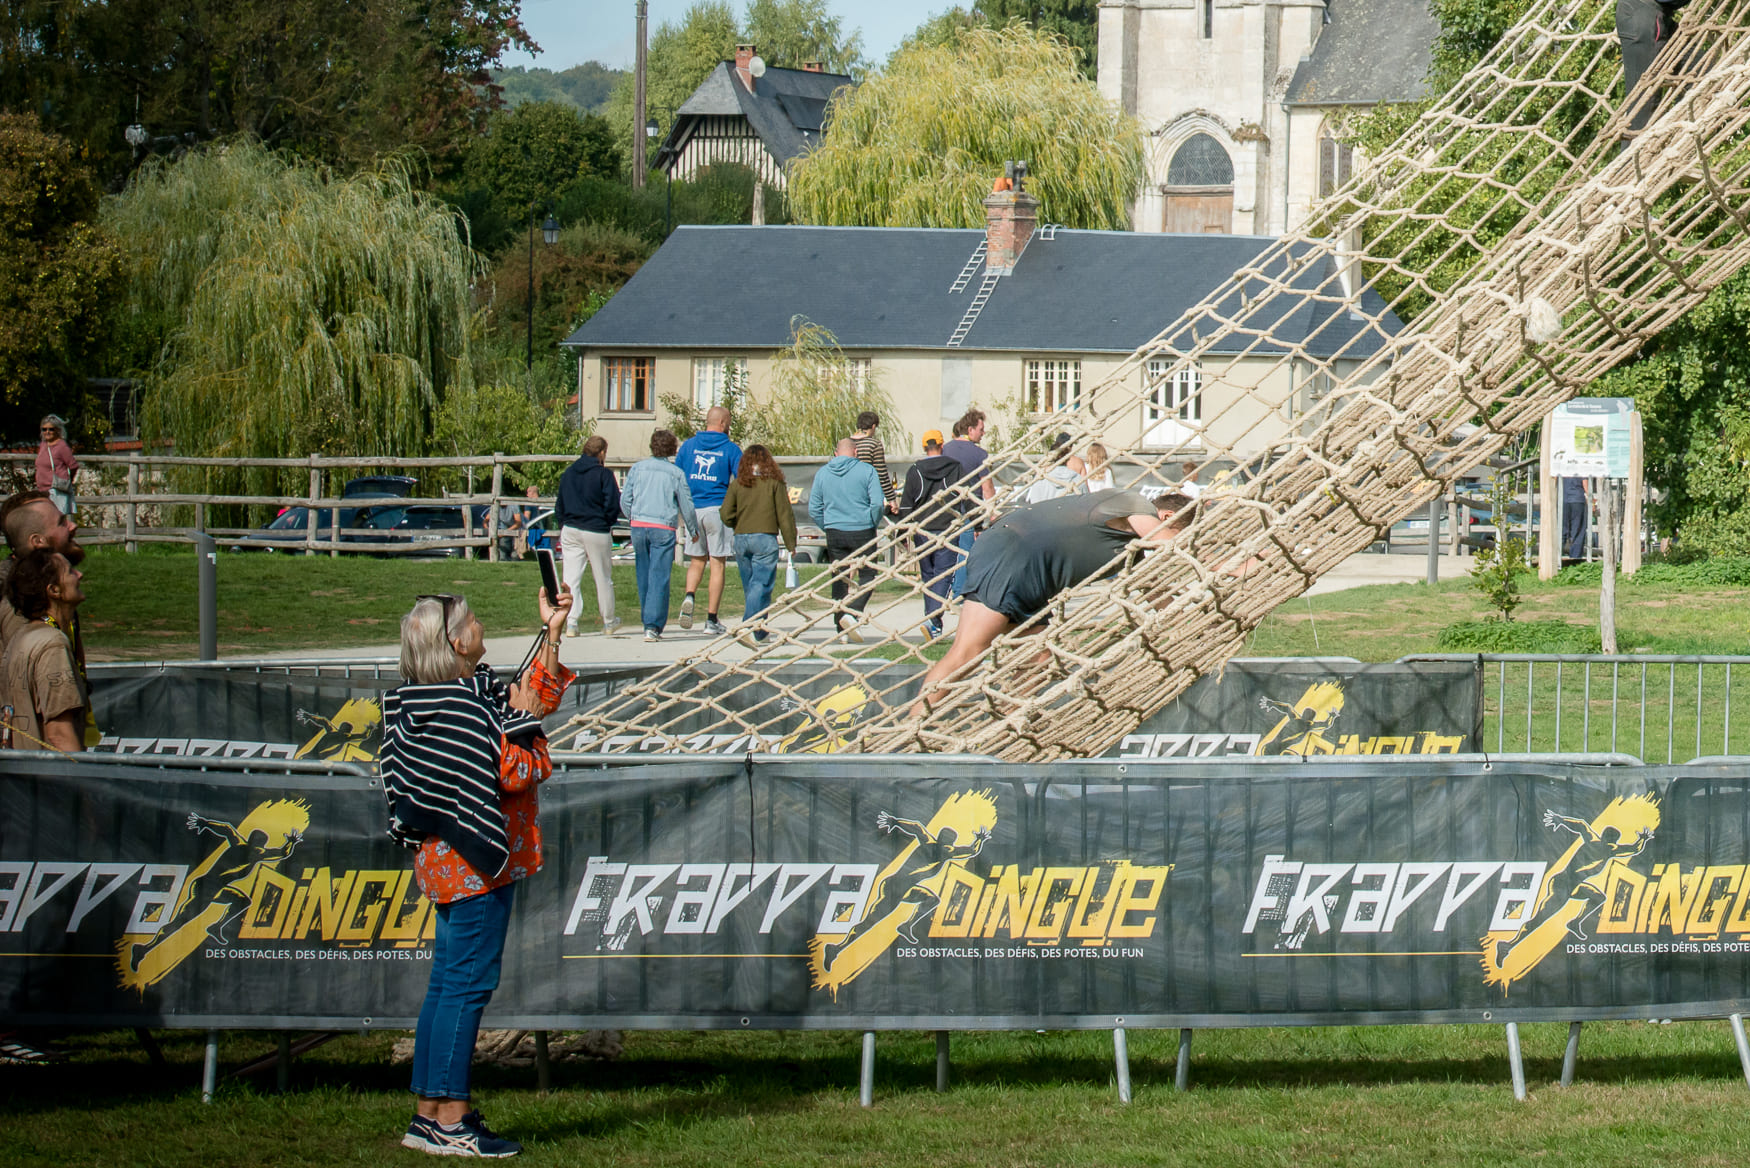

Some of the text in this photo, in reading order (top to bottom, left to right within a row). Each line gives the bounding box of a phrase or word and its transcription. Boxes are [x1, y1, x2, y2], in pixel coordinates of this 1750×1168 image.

[205, 947, 433, 961] DES OBSTACLES, DES DÉFIS, DES POTES, DU
[896, 944, 1144, 960] DES OBSTACLES, DES DÉFIS, DES POTES, DU FUN
[1566, 943, 1586, 954] DES
[1588, 943, 1648, 955] OBSTACLES,
[1650, 943, 1669, 953] DES
[1671, 940, 1701, 954] DÉFIS,
[1703, 942, 1722, 953] DES
